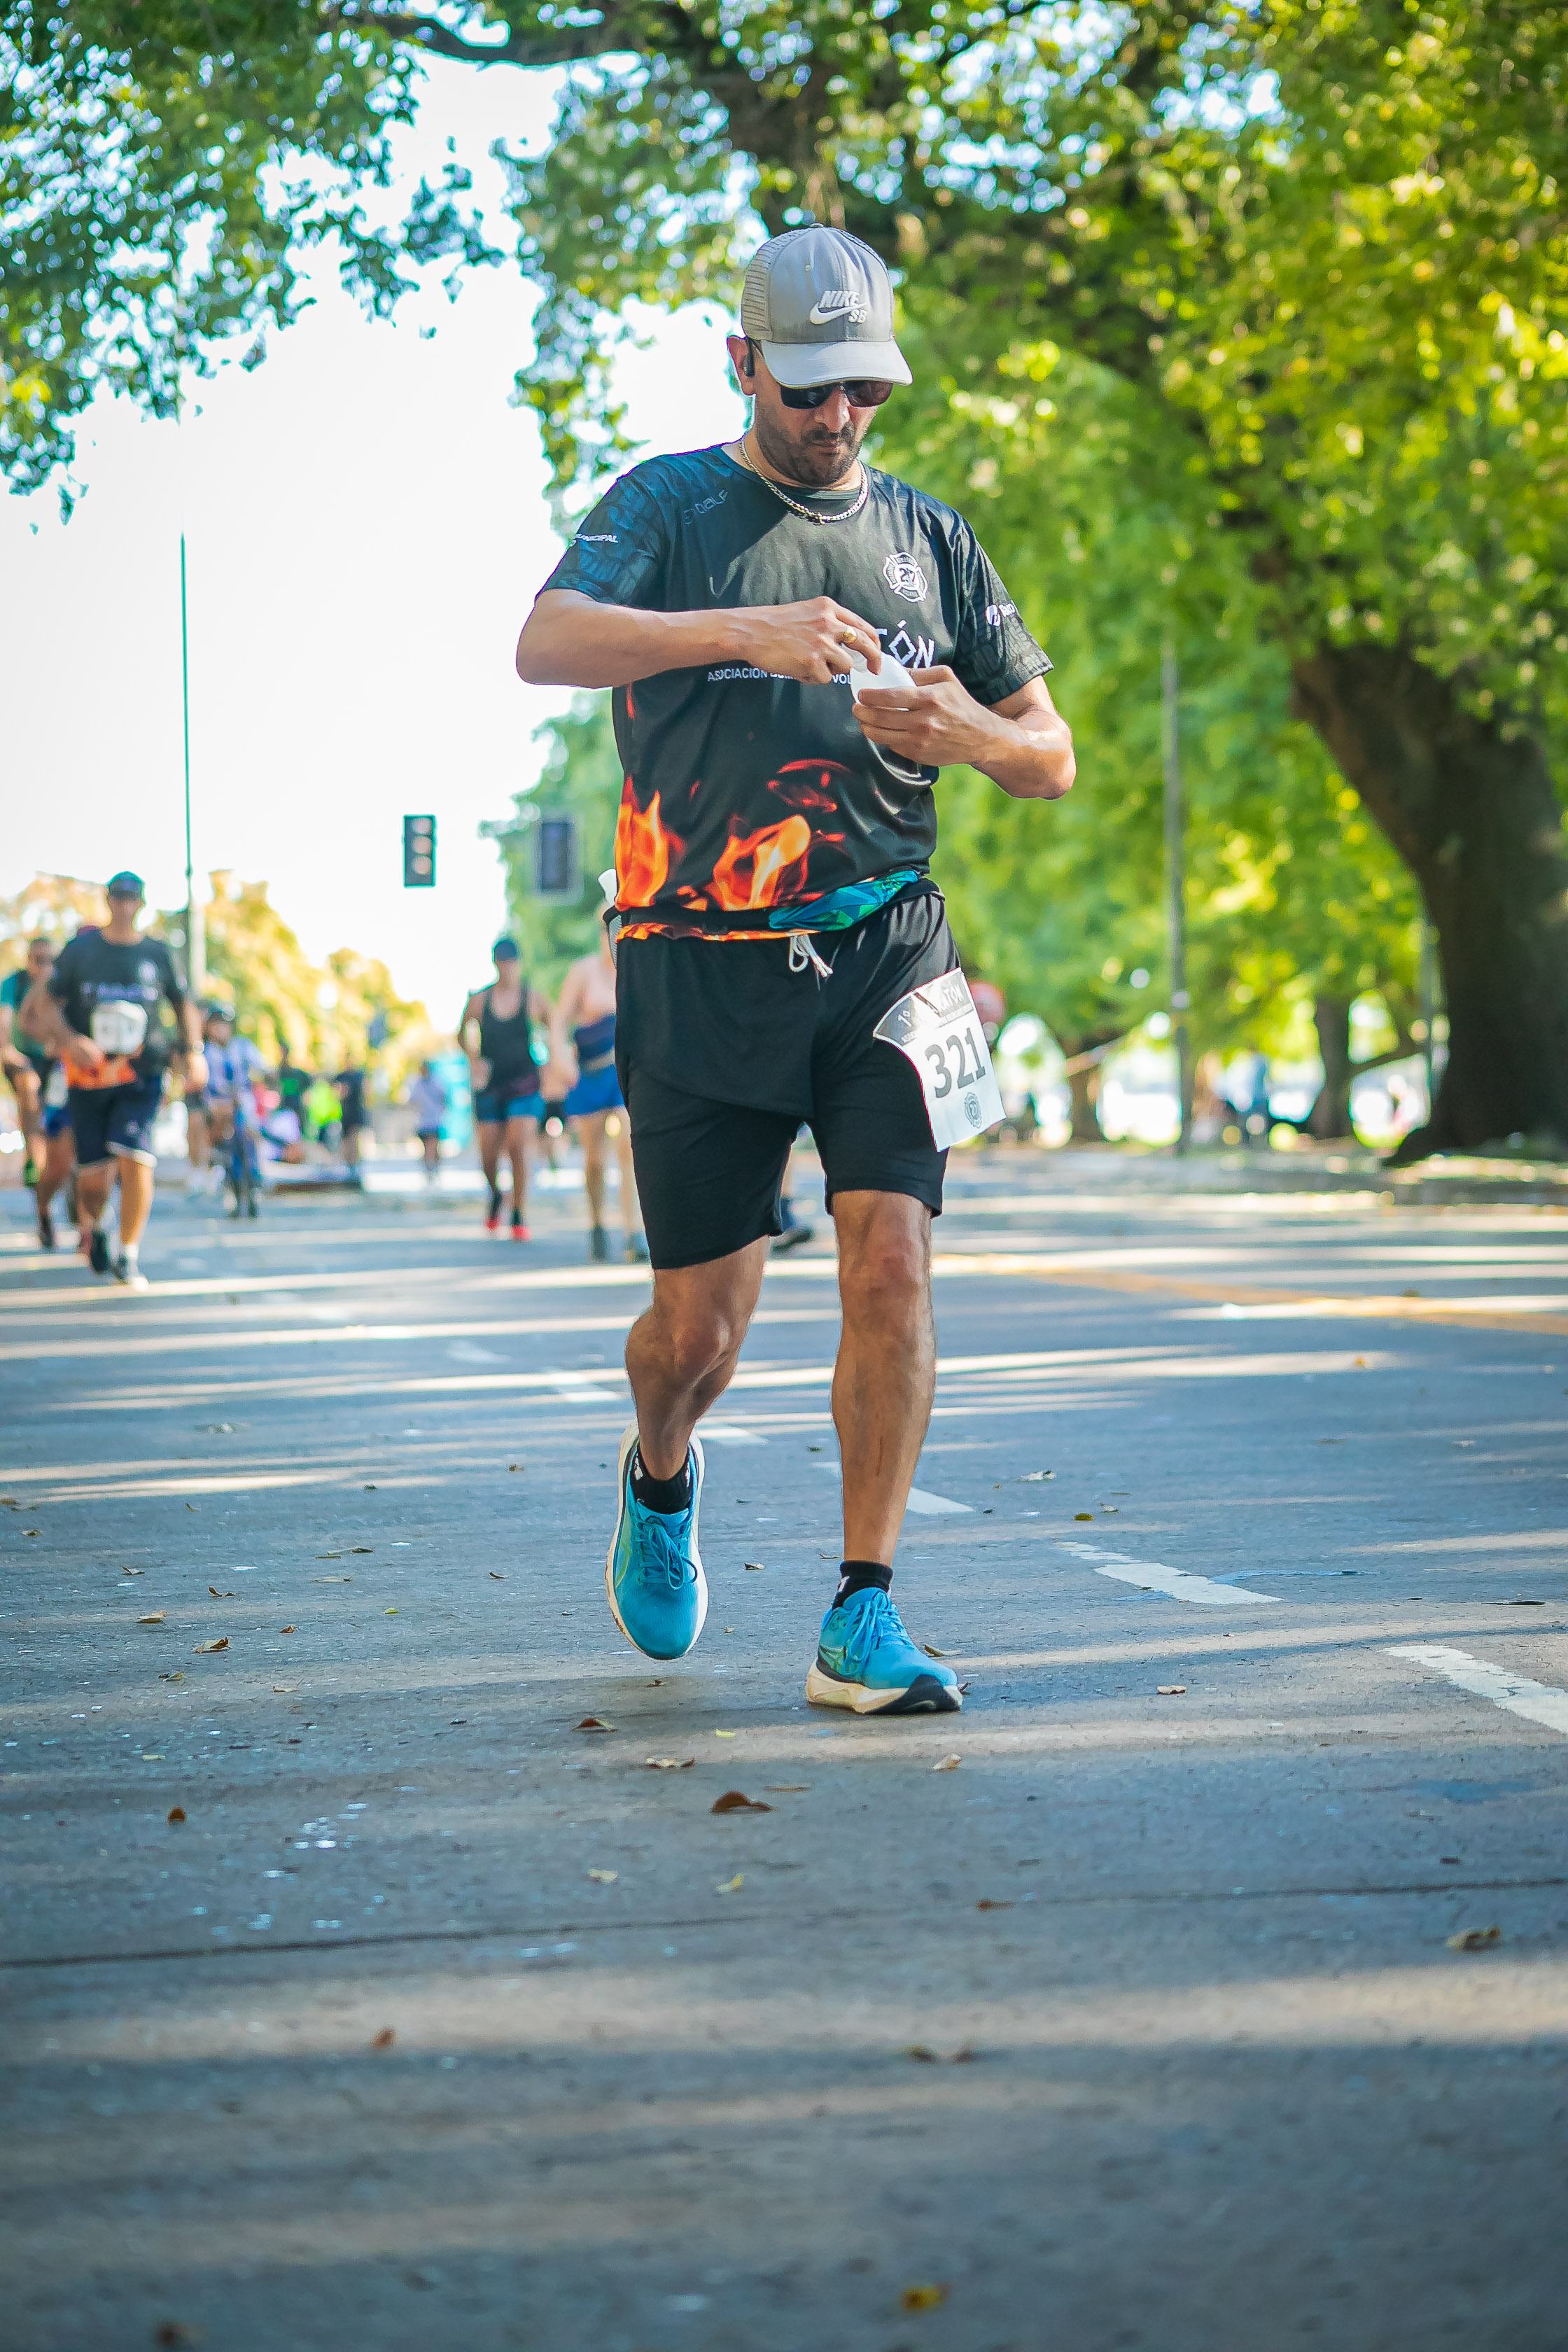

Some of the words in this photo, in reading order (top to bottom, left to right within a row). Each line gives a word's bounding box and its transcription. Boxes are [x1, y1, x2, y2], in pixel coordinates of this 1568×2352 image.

[818, 290, 860, 309] NIKE
[848, 309, 867, 323] SB
[832, 673, 852, 685] VOL
[925, 1027, 986, 1098] 321
